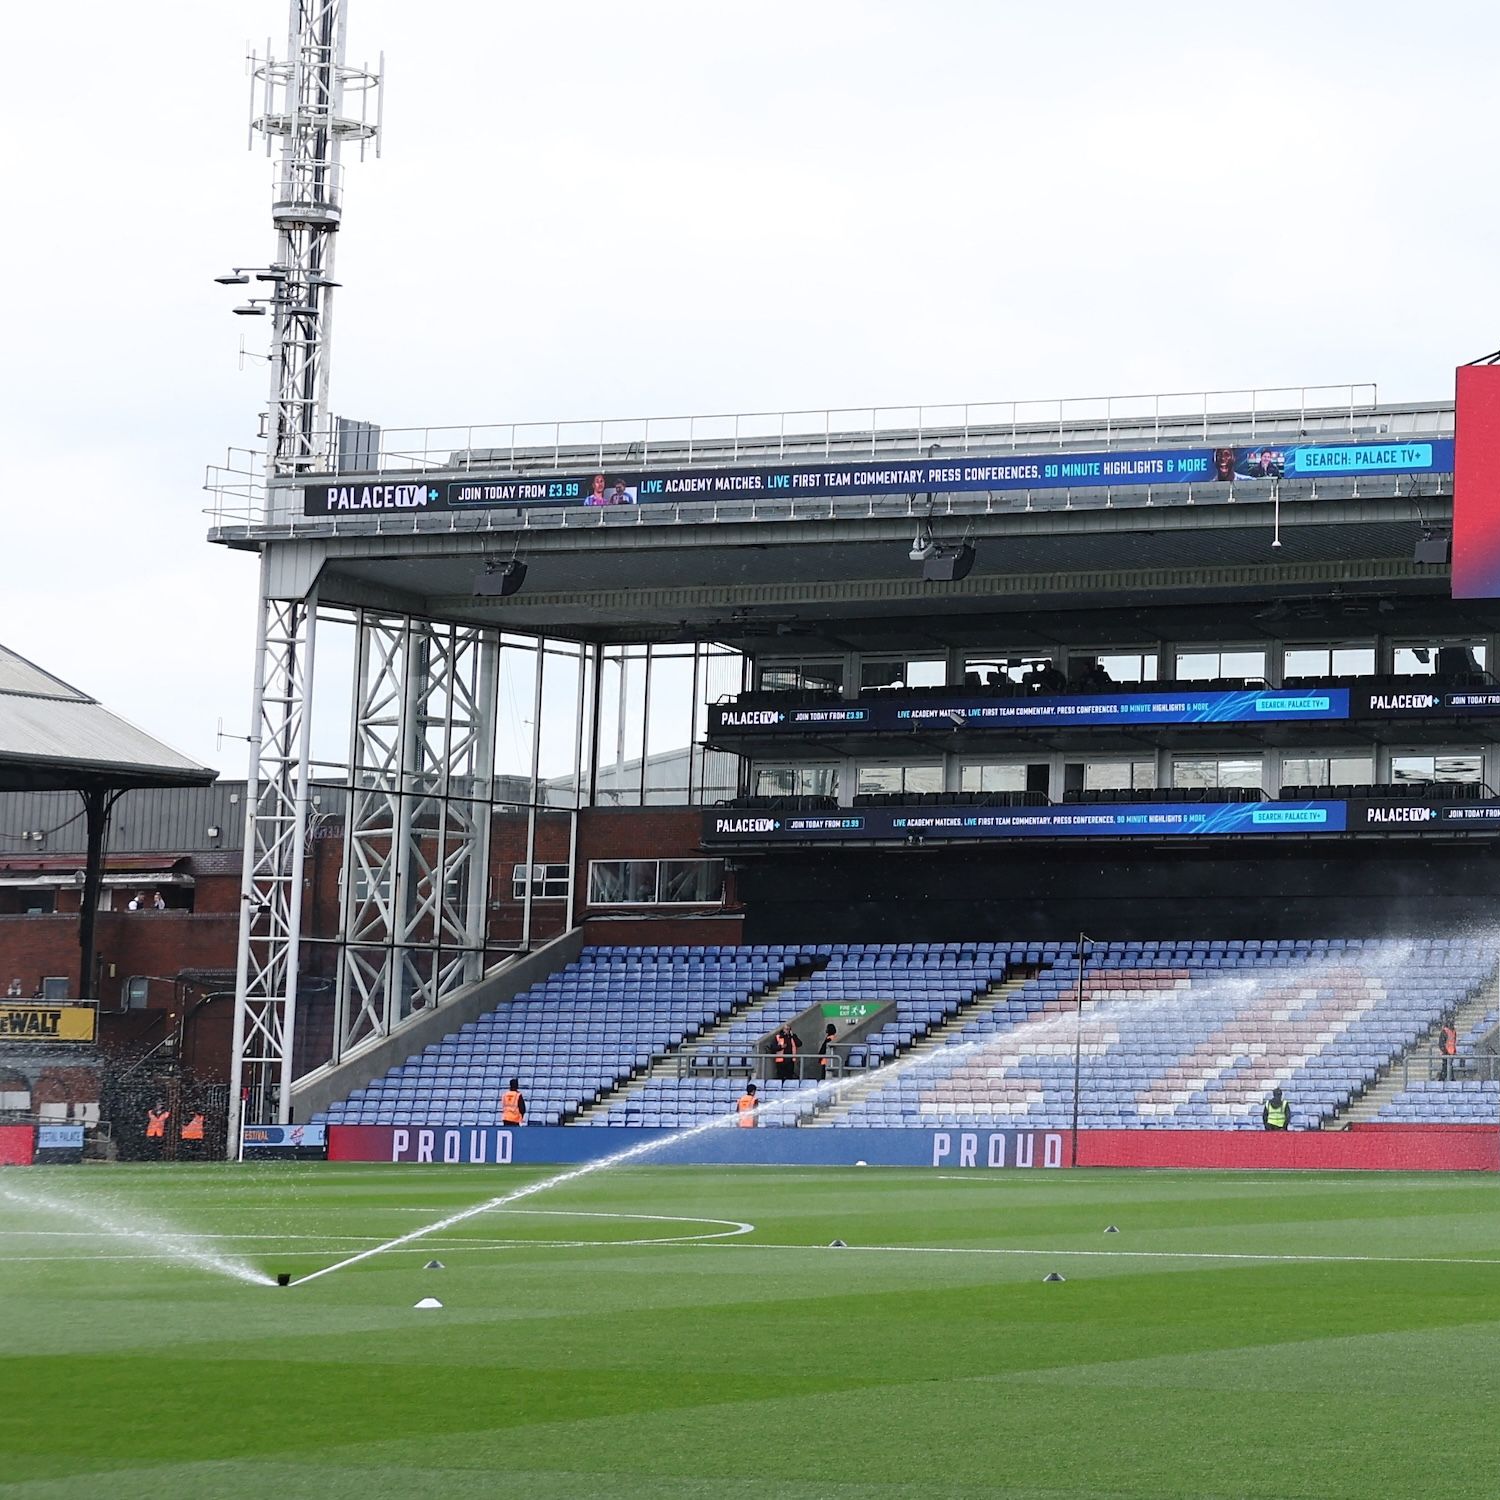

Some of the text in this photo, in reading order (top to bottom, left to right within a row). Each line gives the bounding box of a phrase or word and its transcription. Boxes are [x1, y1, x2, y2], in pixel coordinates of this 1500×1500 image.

[1306, 449, 1420, 466] SEARCH: PALACE TV+
[641, 480, 662, 493] LIVE
[665, 478, 712, 492] ACADEMY
[768, 475, 789, 488] LIVE
[793, 473, 821, 487] FIRST
[824, 472, 850, 486] TEAM
[929, 468, 961, 482] PRESS
[1045, 464, 1058, 478] 90
[1062, 462, 1100, 477] MINUTE
[1104, 460, 1163, 475] HIGHLIGHTS
[1167, 460, 1174, 473] &
[1178, 458, 1207, 473] MORE
[458, 482, 579, 500] JOIN TODAY FROM £3.99
[0, 1012, 61, 1034] EWALT
[244, 1130, 268, 1141] ESTIVAL
[392, 1130, 513, 1163] PROUD
[933, 1133, 1062, 1167] PROUD
